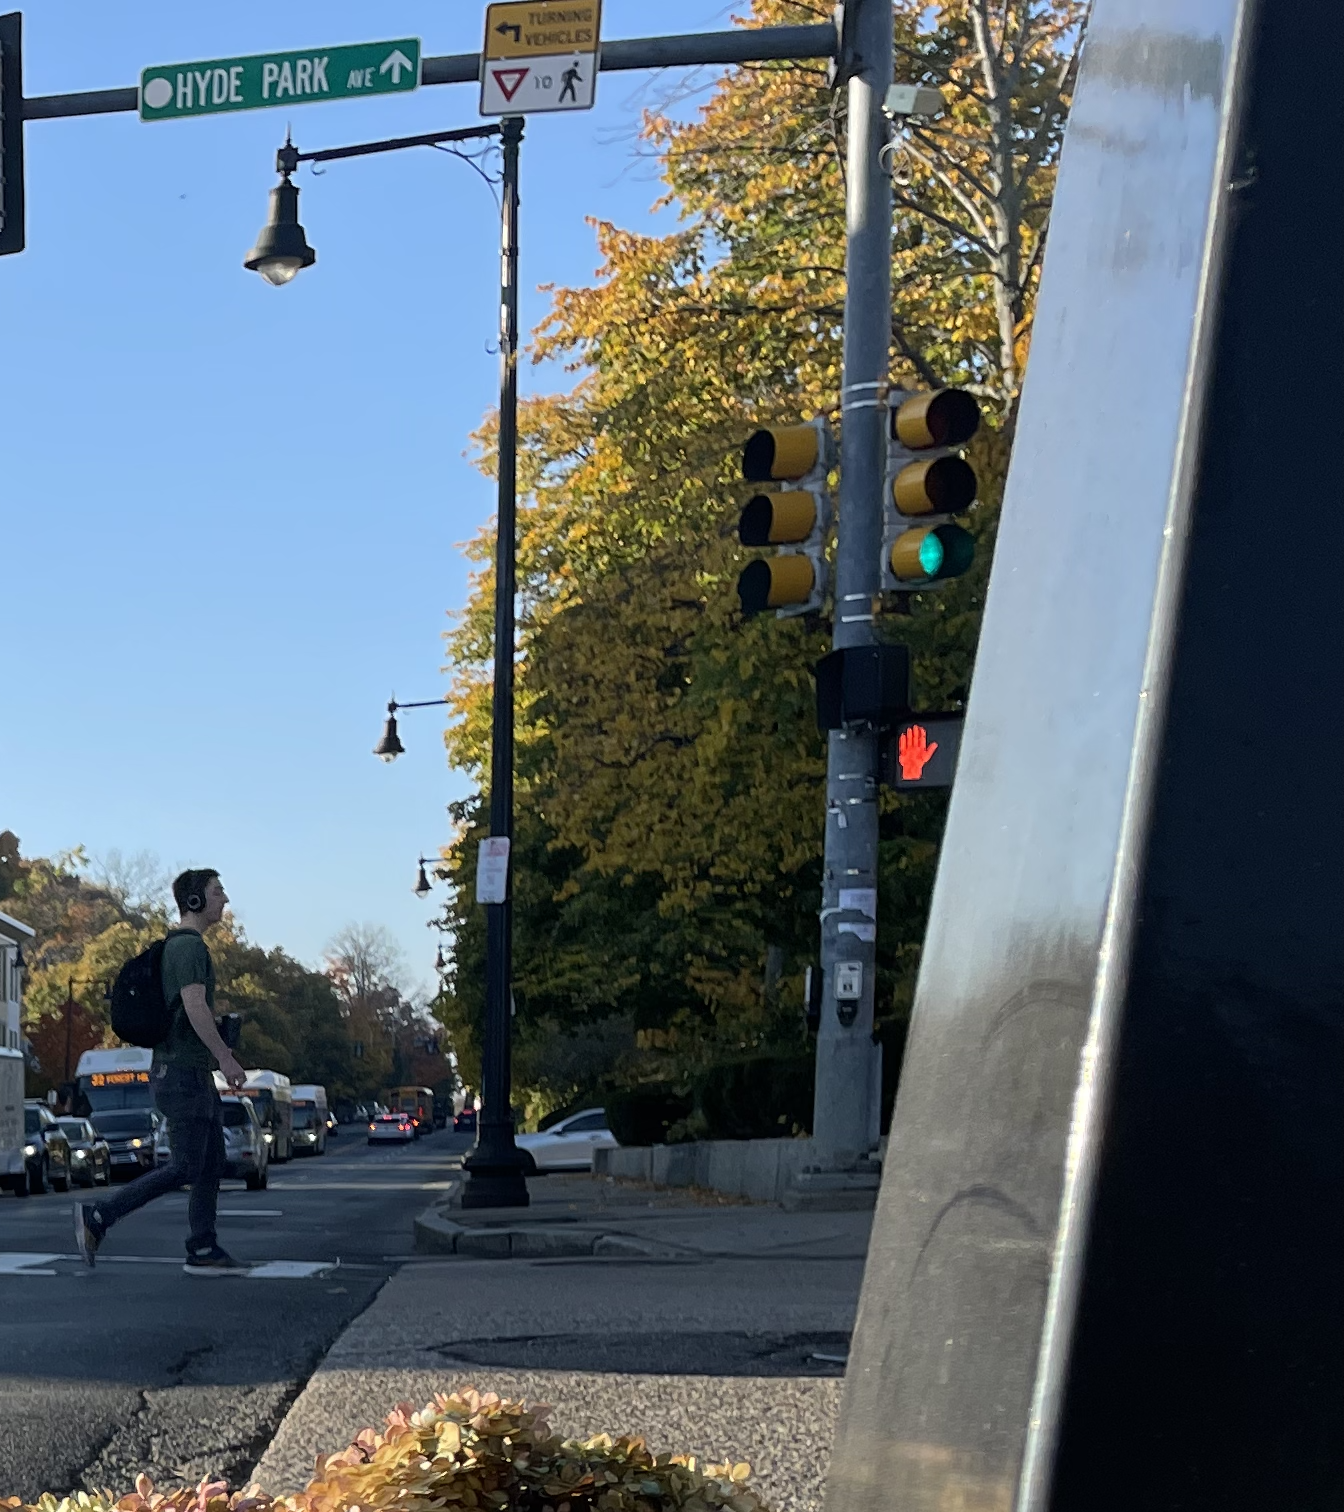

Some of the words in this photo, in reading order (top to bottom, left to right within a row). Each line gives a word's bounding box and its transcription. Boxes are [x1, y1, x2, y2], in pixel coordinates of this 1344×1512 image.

[528, 9, 592, 26] TURNING
[525, 29, 591, 46] VEHICLES
[176, 66, 244, 109] HYDE
[262, 56, 330, 99] PARK
[346, 66, 376, 89] AVE
[534, 75, 553, 89] TO
